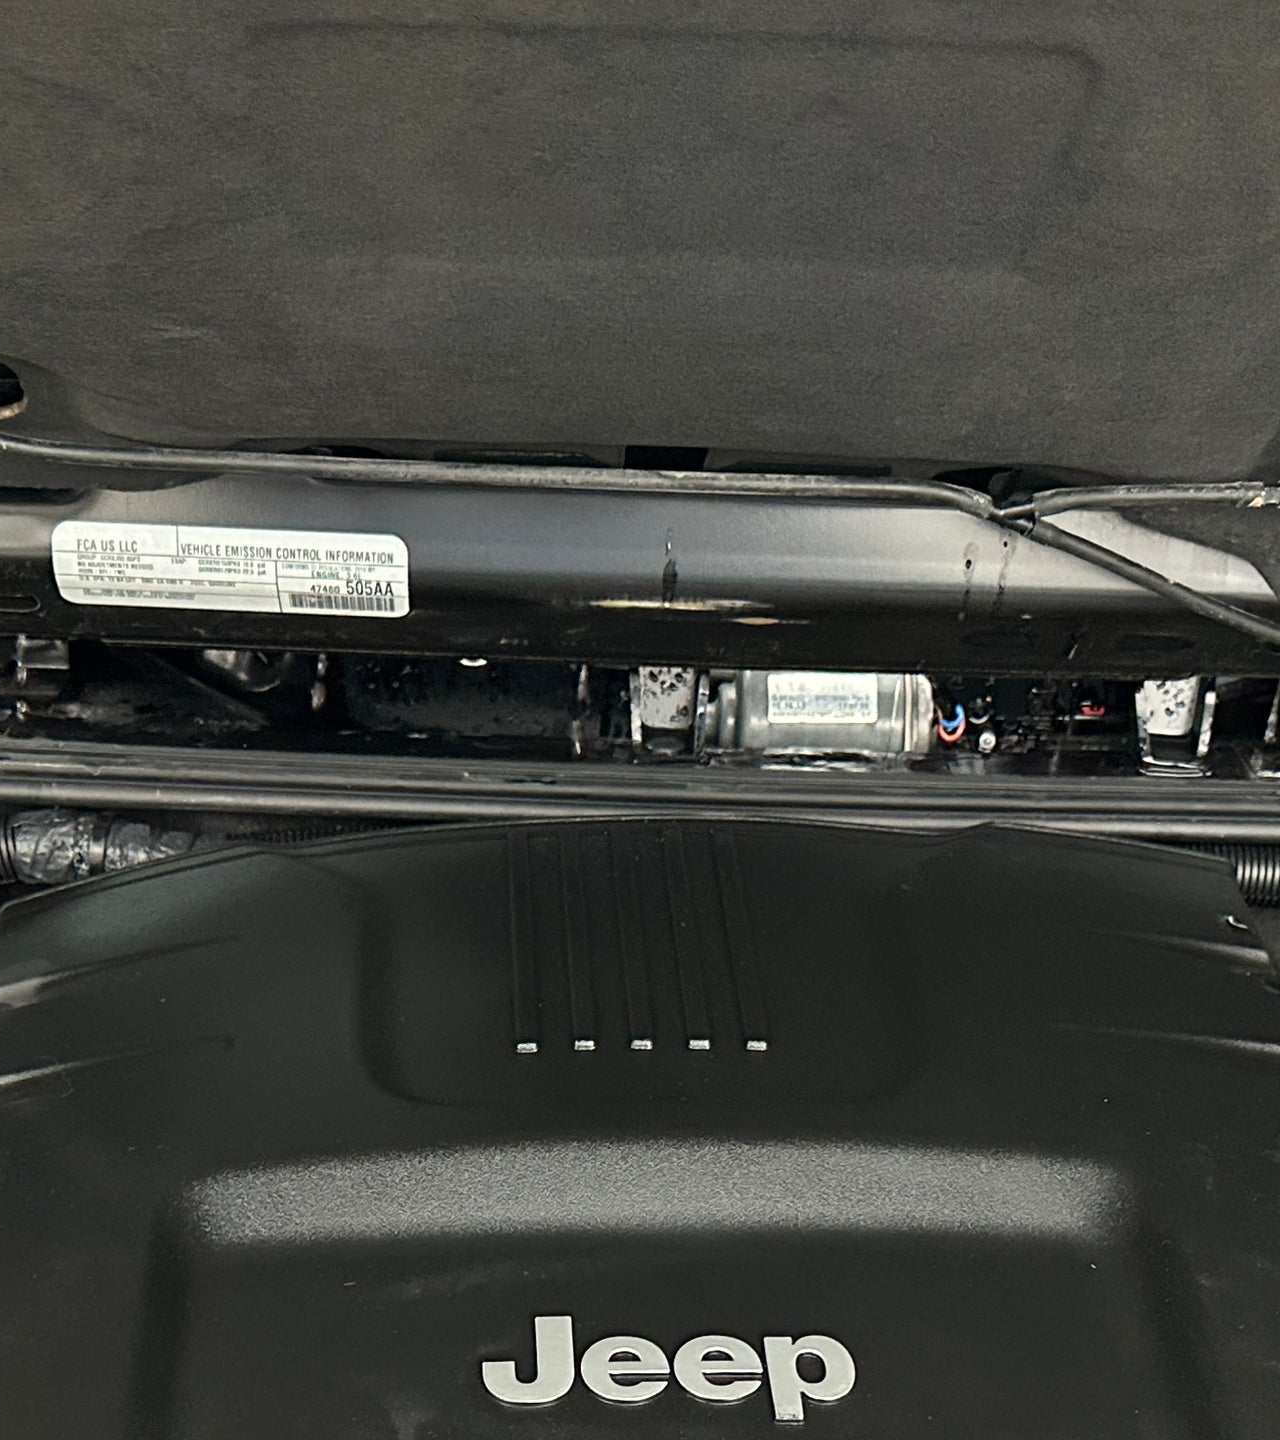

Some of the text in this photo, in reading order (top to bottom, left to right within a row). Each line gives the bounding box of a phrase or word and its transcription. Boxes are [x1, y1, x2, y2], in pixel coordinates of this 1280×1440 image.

[77, 539, 138, 553] FCA US LLC
[180, 544, 394, 564] VEHICLE EMISSION CONTROL INFORMATION
[346, 581, 395, 596] 505AA
[482, 1316, 857, 1425] Jeep
